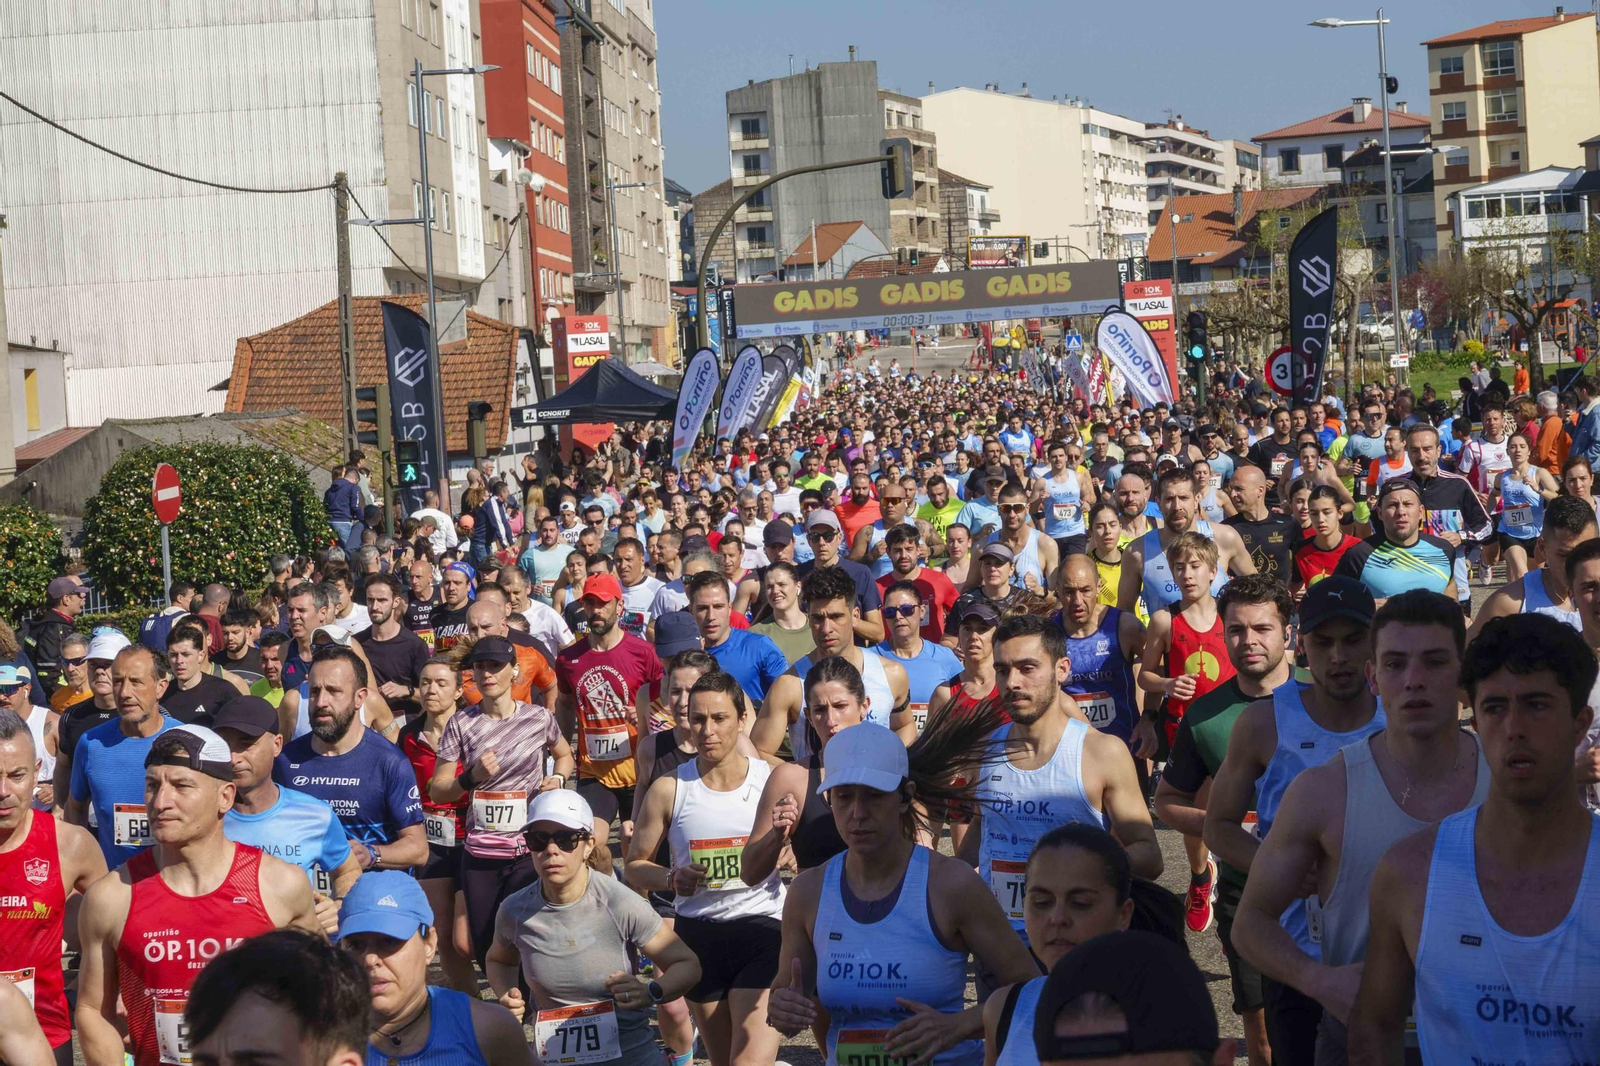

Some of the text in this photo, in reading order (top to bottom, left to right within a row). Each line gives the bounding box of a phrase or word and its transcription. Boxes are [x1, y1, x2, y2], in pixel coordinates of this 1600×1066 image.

[985, 271, 1072, 298] GADIS
[879, 279, 965, 305] GADIS
[773, 286, 859, 313] GADIS
[1139, 301, 1169, 311] LASAL
[883, 314, 933, 327] 00:00:31
[580, 337, 606, 346] LASAL
[574, 356, 605, 367] GAD
[685, 360, 711, 415] Porriño
[729, 357, 756, 407] Porriño
[1511, 511, 1525, 522] 571
[595, 738, 620, 754] 774
[311, 777, 360, 786] HYUNDAI
[335, 808, 357, 816] 2025
[486, 805, 514, 824] 977
[285, 845, 301, 856] DE
[317, 870, 333, 891] 6
[549, 1017, 580, 1027] PATRICIA
[555, 1024, 601, 1054] 779
